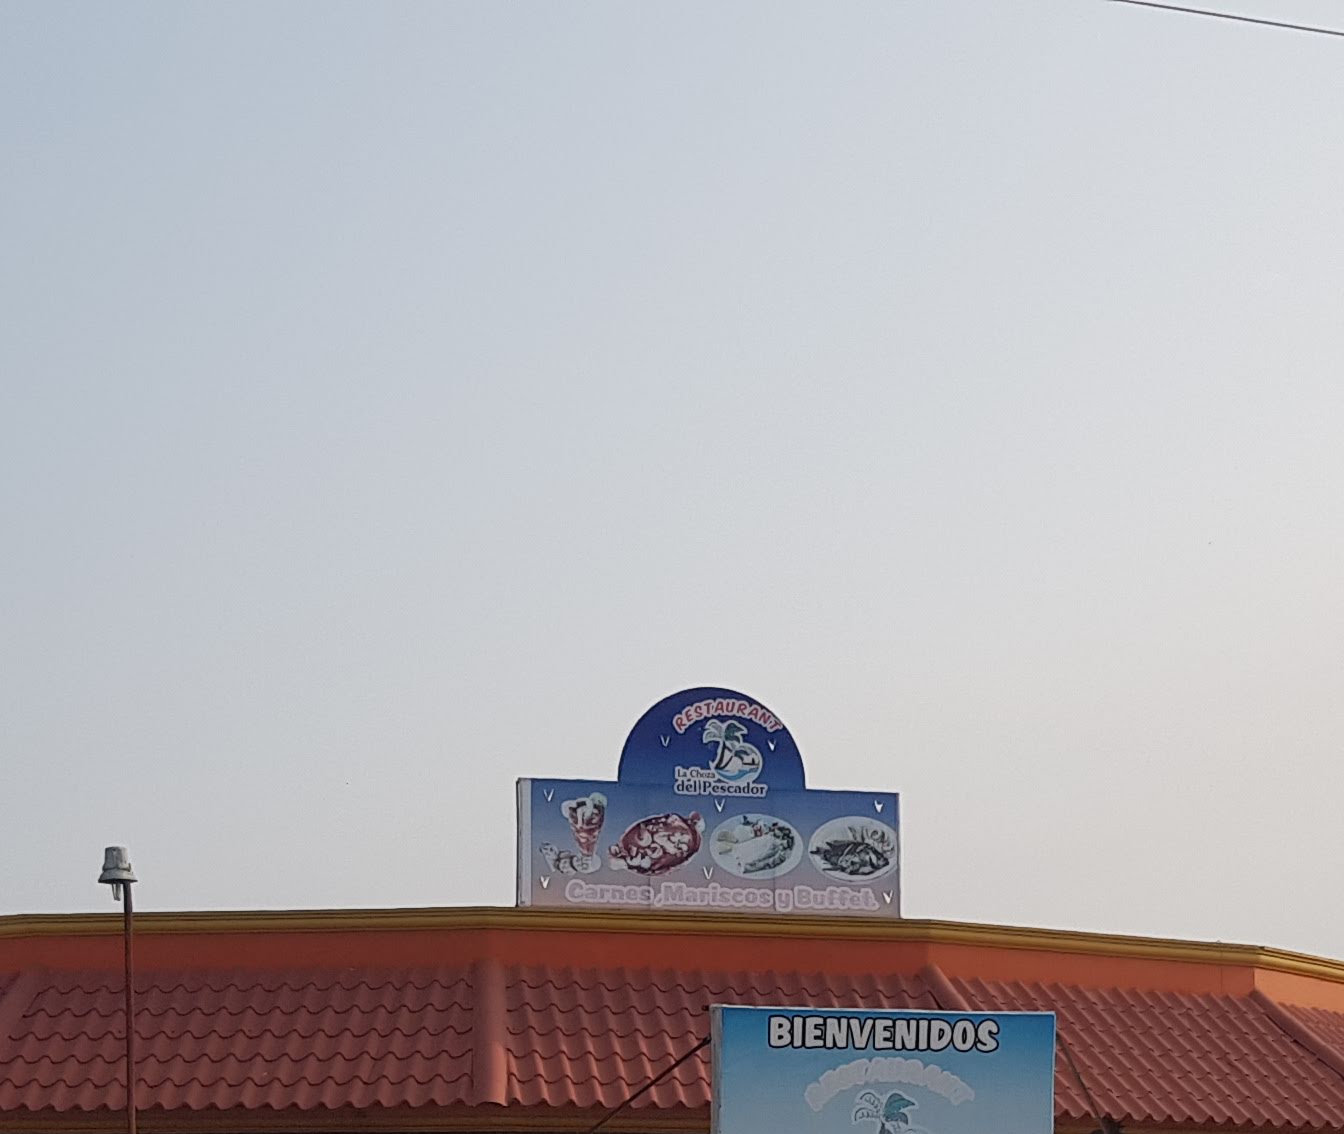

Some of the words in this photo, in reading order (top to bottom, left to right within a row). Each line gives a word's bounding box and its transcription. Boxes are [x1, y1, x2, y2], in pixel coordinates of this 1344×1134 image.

[674, 699, 783, 733] RESTAURANT
[677, 769, 687, 778] La
[690, 769, 716, 779] Choza
[676, 781, 697, 793] del
[702, 781, 766, 795] Pescador
[774, 888, 791, 912] y
[768, 1014, 1000, 1053] BIENVENIDOS
